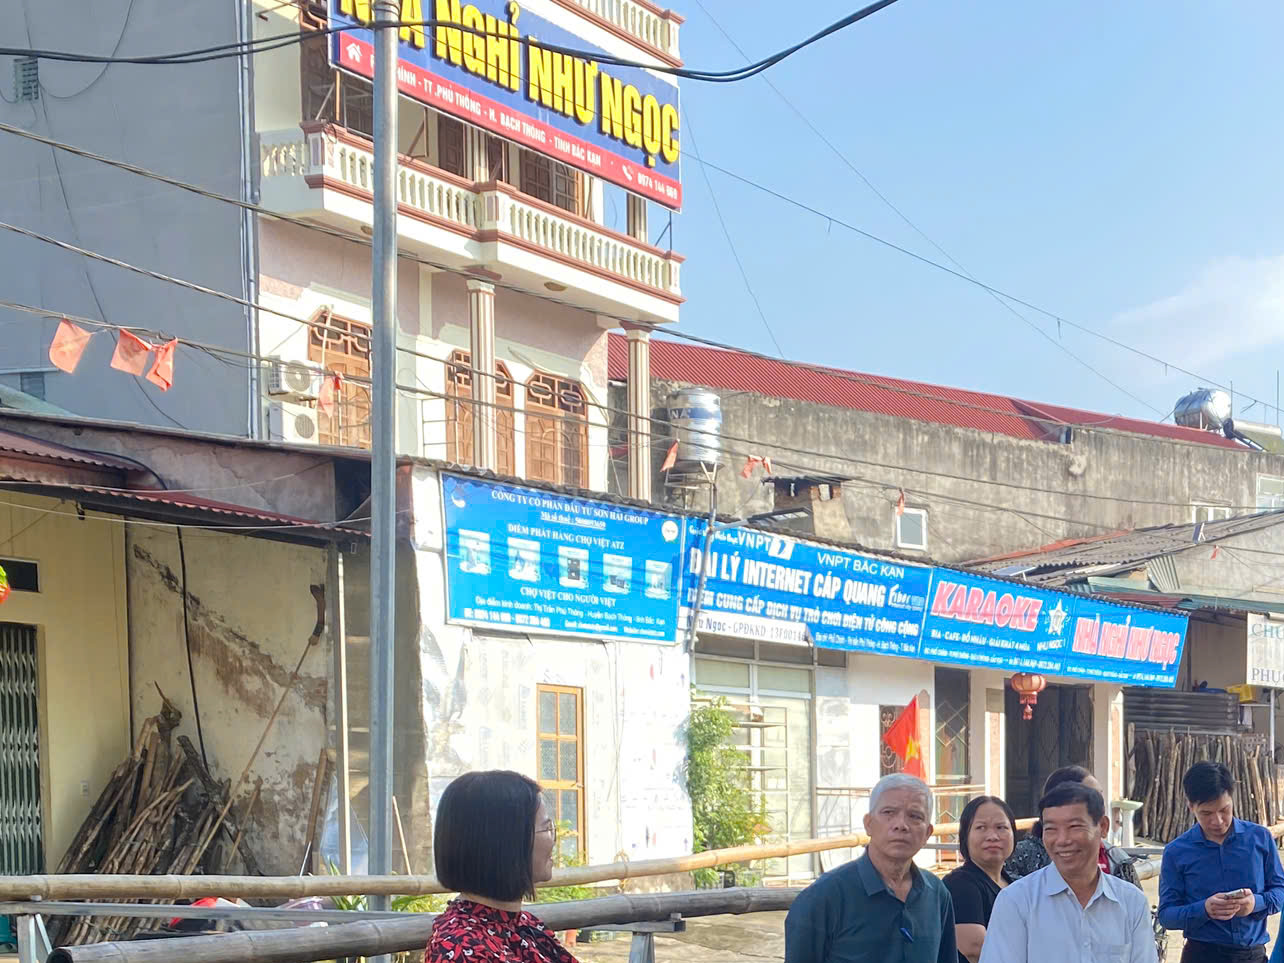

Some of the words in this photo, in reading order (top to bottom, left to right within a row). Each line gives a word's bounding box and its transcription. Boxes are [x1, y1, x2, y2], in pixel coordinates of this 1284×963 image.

[456, 91, 482, 116] THÔNG
[528, 36, 599, 125] NHƯ
[600, 71, 680, 168] NGỌC
[516, 494, 528, 505] TY
[624, 513, 649, 526] GROUP
[738, 530, 772, 552] VNPT
[817, 552, 852, 569] VNPT
[721, 551, 741, 582] LÝ
[743, 559, 812, 596] INTERNET
[813, 571, 841, 600] CÁP
[842, 579, 887, 608] QUANG
[716, 592, 744, 611] CUNG
[930, 580, 1043, 633] KARAOKE
